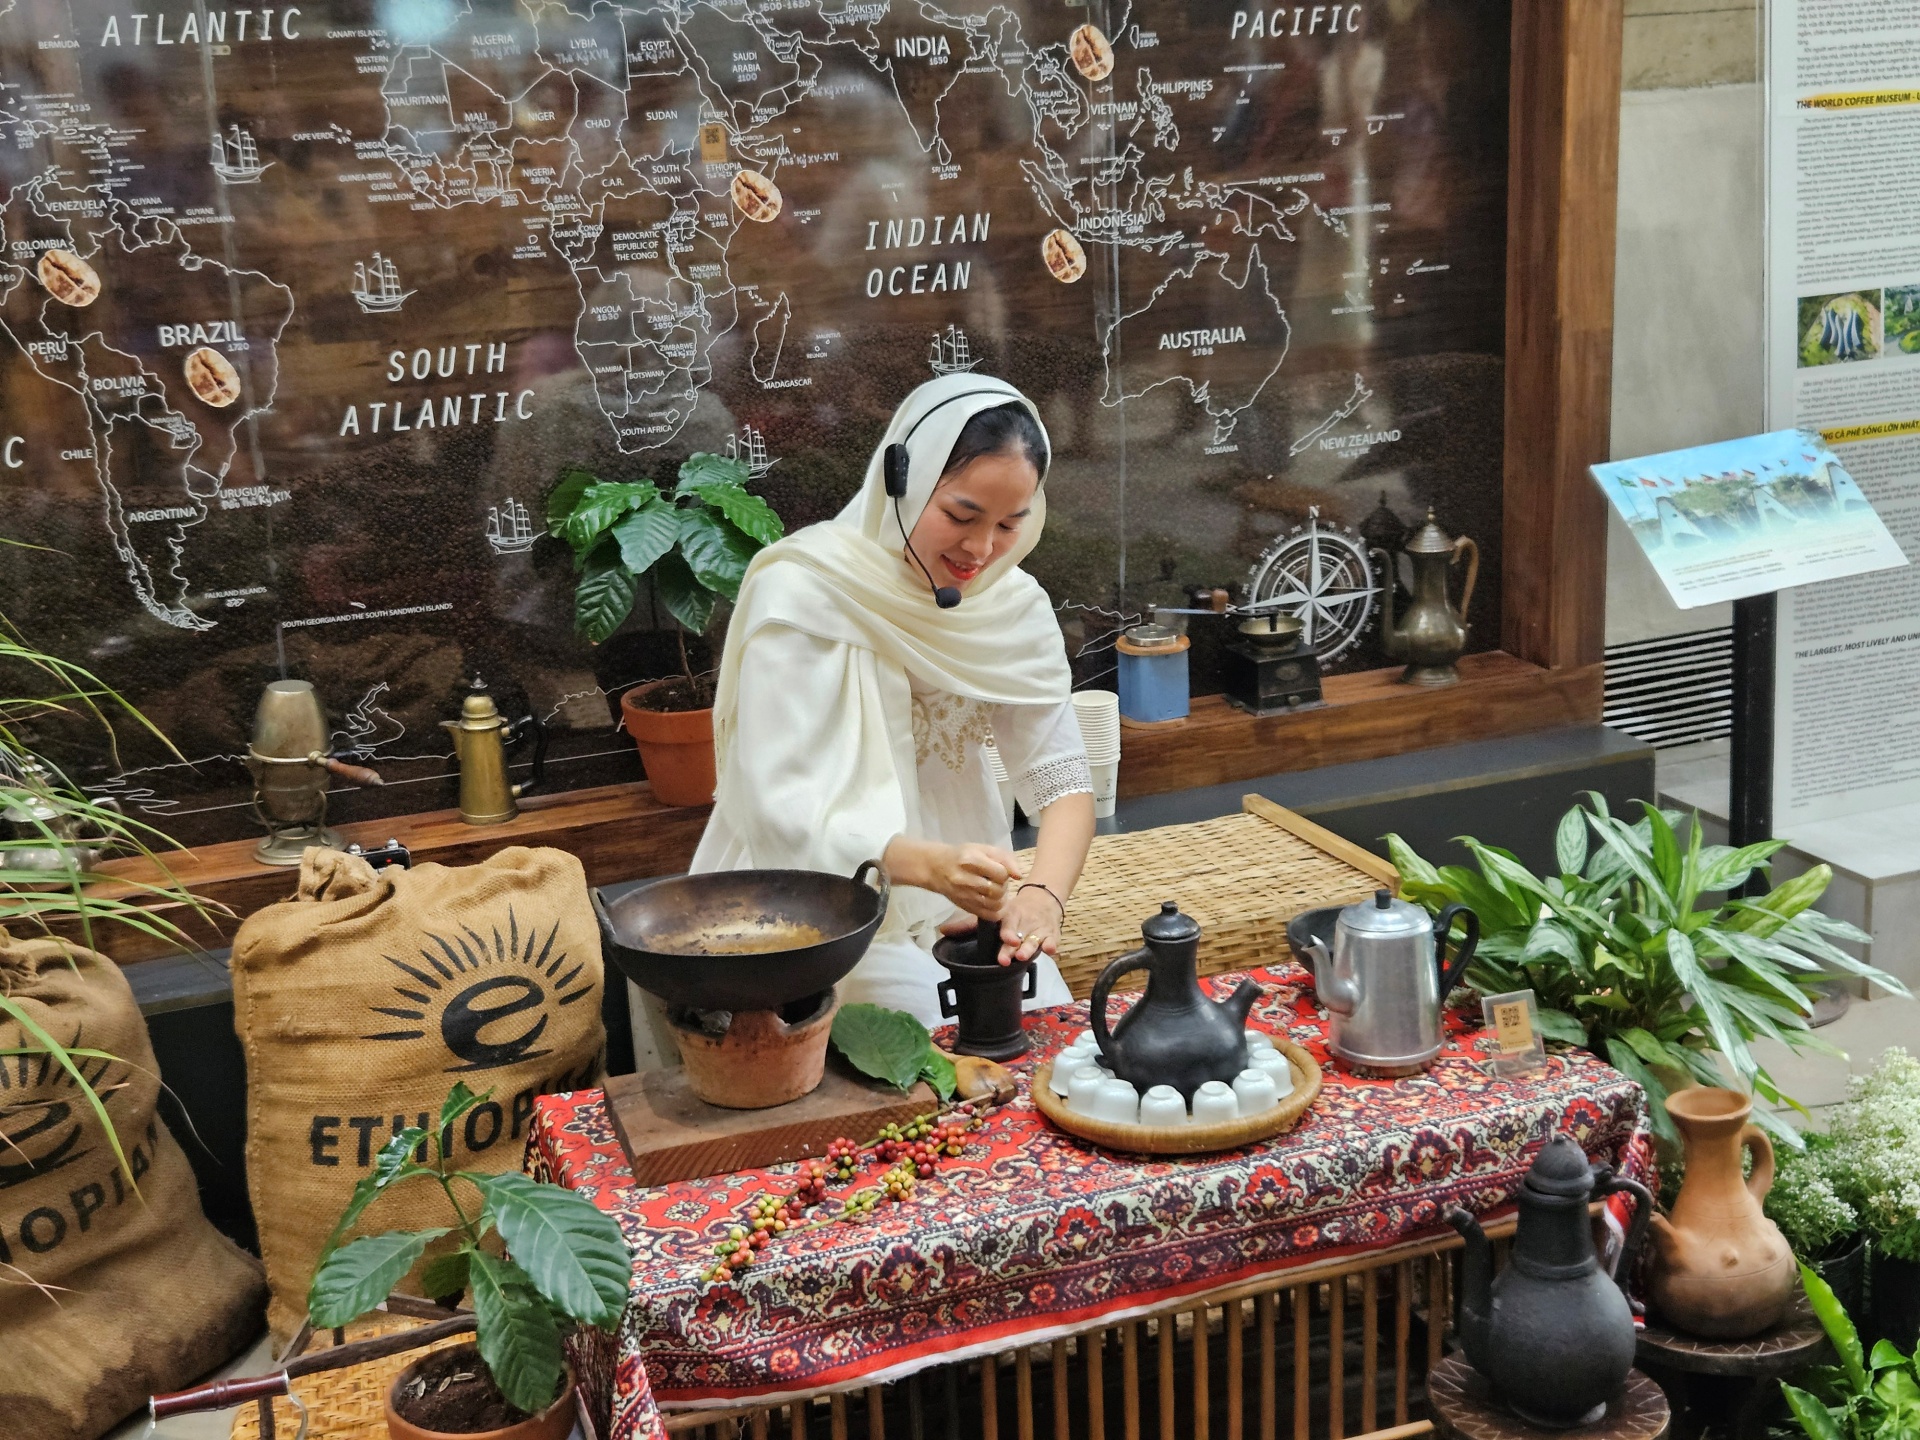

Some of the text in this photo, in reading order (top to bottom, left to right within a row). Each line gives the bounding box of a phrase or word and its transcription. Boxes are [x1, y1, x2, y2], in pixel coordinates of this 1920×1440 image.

[848, 4, 891, 14] PAKISTAN
[1231, 4, 1362, 40] PACIFIC
[101, 8, 300, 47] ATLANTIC
[327, 30, 357, 39] CANARY
[38, 40, 80, 49] BERMUDA
[472, 35, 514, 46] ALGERIA
[570, 38, 598, 49] LYBIA
[640, 40, 670, 51] EGYPT
[896, 36, 951, 58] INDIA
[355, 56, 389, 64] WESTERN
[733, 52, 757, 61] SAUDI
[929, 56, 949, 66] 1650
[358, 65, 388, 73] SAHARA
[732, 63, 761, 73] ARABIA
[737, 73, 757, 82] 1100
[797, 79, 817, 88] OMAN
[1151, 80, 1213, 94] PHILIPPINES
[1033, 90, 1063, 98] THAILAND
[390, 96, 448, 106] MAURITANIA
[1797, 92, 1911, 109] THE WORLD COFFEE MUSEUM
[757, 107, 778, 115] YEMEN
[1090, 102, 1138, 115] VIETNAM
[464, 113, 487, 122] MALI
[528, 112, 555, 121] NIGER
[646, 111, 678, 121] SUDAN
[703, 111, 729, 119] ERITREA
[585, 119, 611, 128] CHAD
[293, 131, 334, 142] CAPE VERDE
[354, 141, 387, 150] SENEGAL
[357, 151, 386, 160] GAMBIA
[755, 147, 791, 157] SOMALIA
[652, 164, 680, 174] SOUTH
[705, 162, 742, 172] ETHIOPIA
[339, 172, 392, 182] GUINEA-BISSAU
[522, 168, 556, 178] NIGERIA
[653, 175, 682, 185] SUDAN
[1259, 176, 1282, 186] PAPUA
[1283, 175, 1299, 184] NEW
[368, 192, 416, 202] SIERRA LEONE
[448, 189, 471, 197] COAST
[45, 199, 107, 212] VENEZUELA
[130, 197, 162, 206] GUYANA
[142, 207, 175, 215] SURINAME
[185, 208, 214, 216] GUYANE
[411, 203, 437, 211] LIBERIA
[542, 203, 581, 212] CAMEROON
[704, 213, 728, 221] KENYA
[1080, 213, 1146, 230] INDONESIA
[613, 231, 660, 241] DEMOCRATIC
[866, 213, 990, 250] INDIAN
[11, 239, 67, 251] COLOMBIA
[613, 242, 646, 251] REPUBLIC
[648, 241, 659, 249] OF
[616, 251, 659, 261] THE CONGO
[689, 264, 722, 273] TANZANIA
[866, 262, 970, 298] OCEAN
[591, 305, 622, 314] ANGOLA
[647, 314, 676, 323] ZAMBIA
[159, 321, 246, 347] BRAZIL
[1159, 327, 1246, 350] AUSTRALIA
[28, 341, 67, 356] PERU
[659, 343, 694, 351] ZIMBABWE
[44, 353, 68, 363] 1740
[387, 342, 507, 382] SOUTH
[595, 365, 624, 374] NAMIBIA
[629, 370, 665, 380] BOTSWANA
[93, 375, 147, 392] BOLIVIA
[764, 378, 812, 390] MADAGASCAR
[340, 389, 536, 437] ATLANTIC
[621, 425, 673, 437] SOUTH AFRICA
[1819, 431, 1833, 441] NG
[1320, 429, 1401, 450] NEW ZEALAND
[5, 436, 25, 469] C
[1204, 444, 1238, 455] TASMANIA
[61, 449, 93, 461] CHILE
[220, 485, 270, 499] URUGUAY
[129, 506, 198, 523] ARGENTINA
[204, 586, 267, 599] FALKLAND ISLANDS
[282, 602, 453, 629] SOUTH GEORGIA AND THE SOUTH SANDWICH ISLANDS
[1794, 651, 1808, 660] THE
[1845, 641, 1865, 651] MOST
[1866, 637, 1889, 648] LIVELY
[1890, 634, 1906, 644] AND
[309, 1070, 575, 1168] ETHIOP
